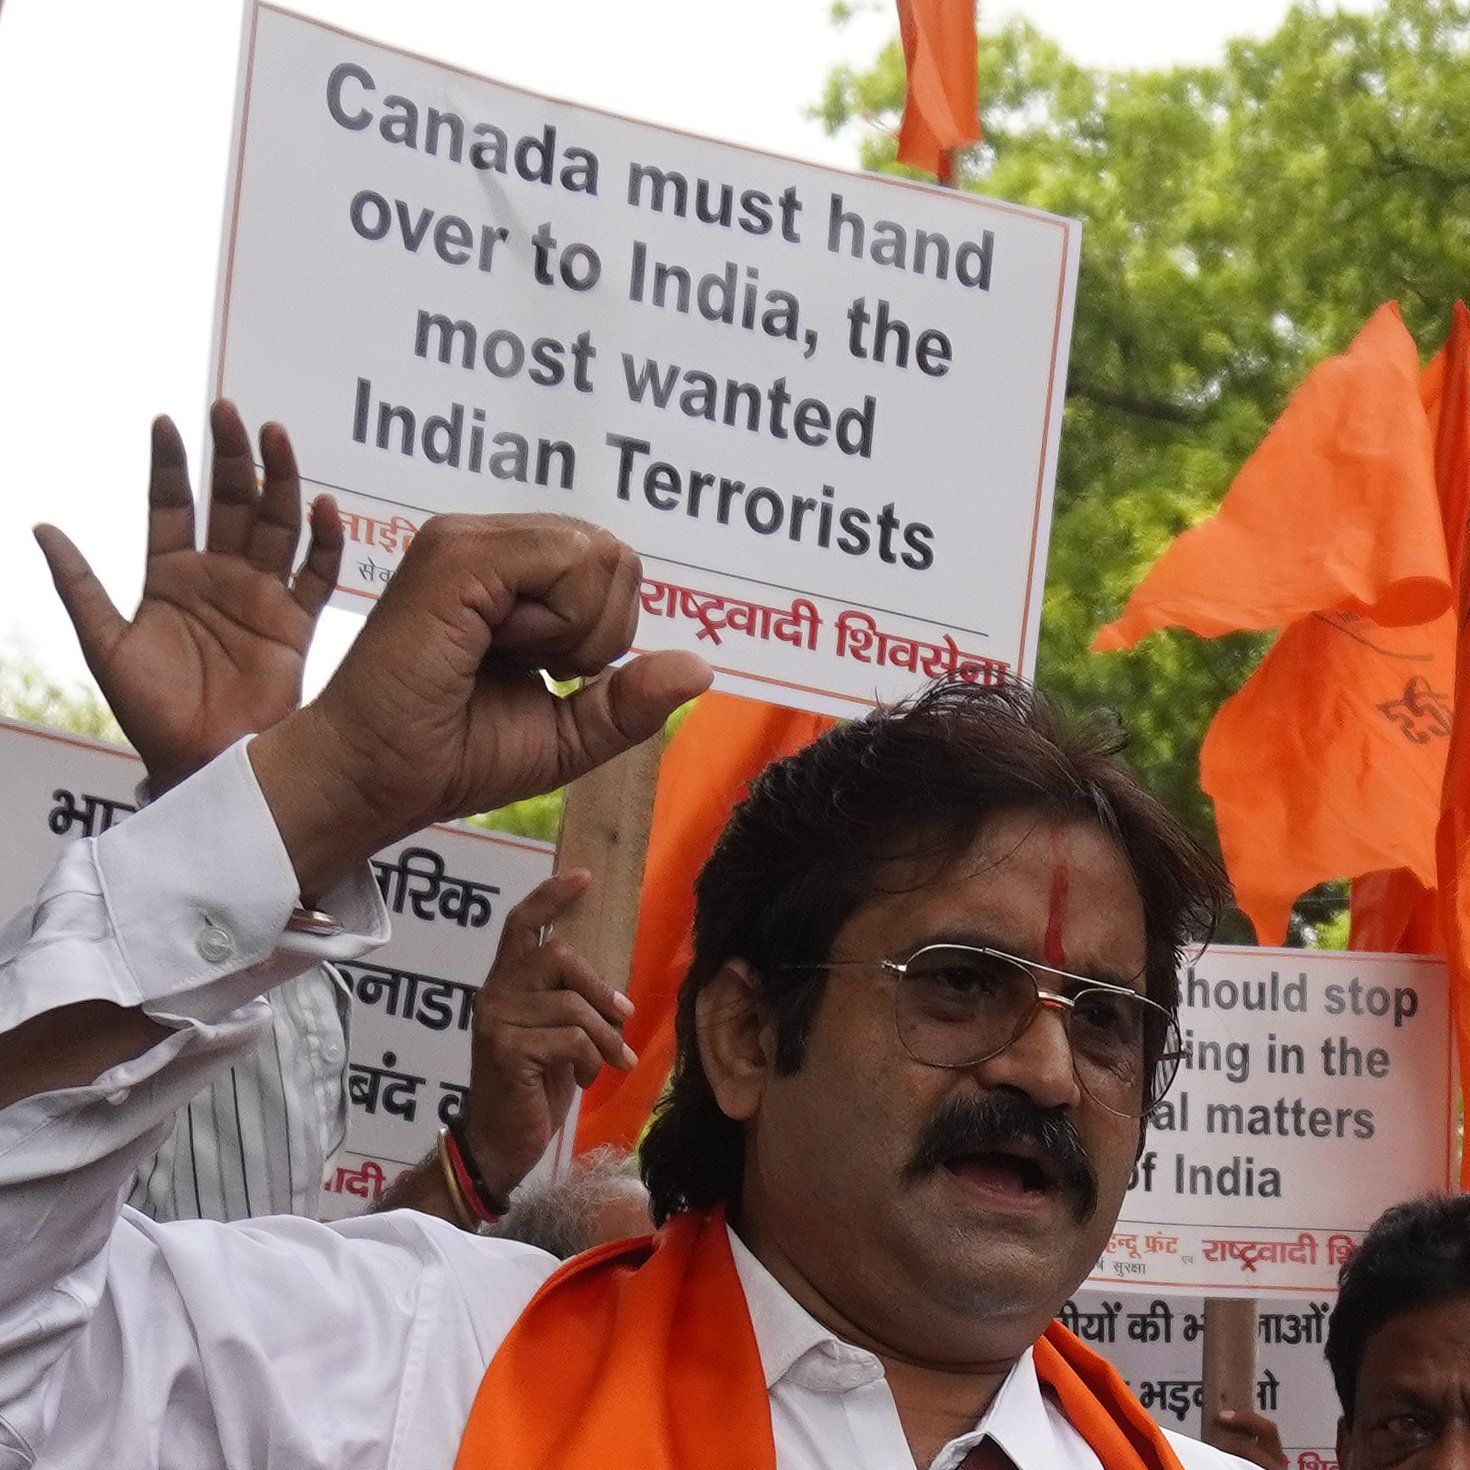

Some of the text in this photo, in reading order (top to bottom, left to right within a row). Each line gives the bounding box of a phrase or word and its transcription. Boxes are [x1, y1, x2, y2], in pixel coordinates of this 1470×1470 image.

[326, 62, 996, 293] Canada must hand
[349, 188, 954, 378] over to India, the
[413, 307, 877, 459] most wanted
[351, 377, 937, 573] Indian Terrorists
[1323, 976, 1419, 1028] stop
[1267, 1033, 1305, 1075] in
[1320, 1035, 1391, 1079] the
[1205, 1096, 1376, 1140] matters
[1174, 1153, 1283, 1199] India
[1126, 1299, 1174, 1345] की
